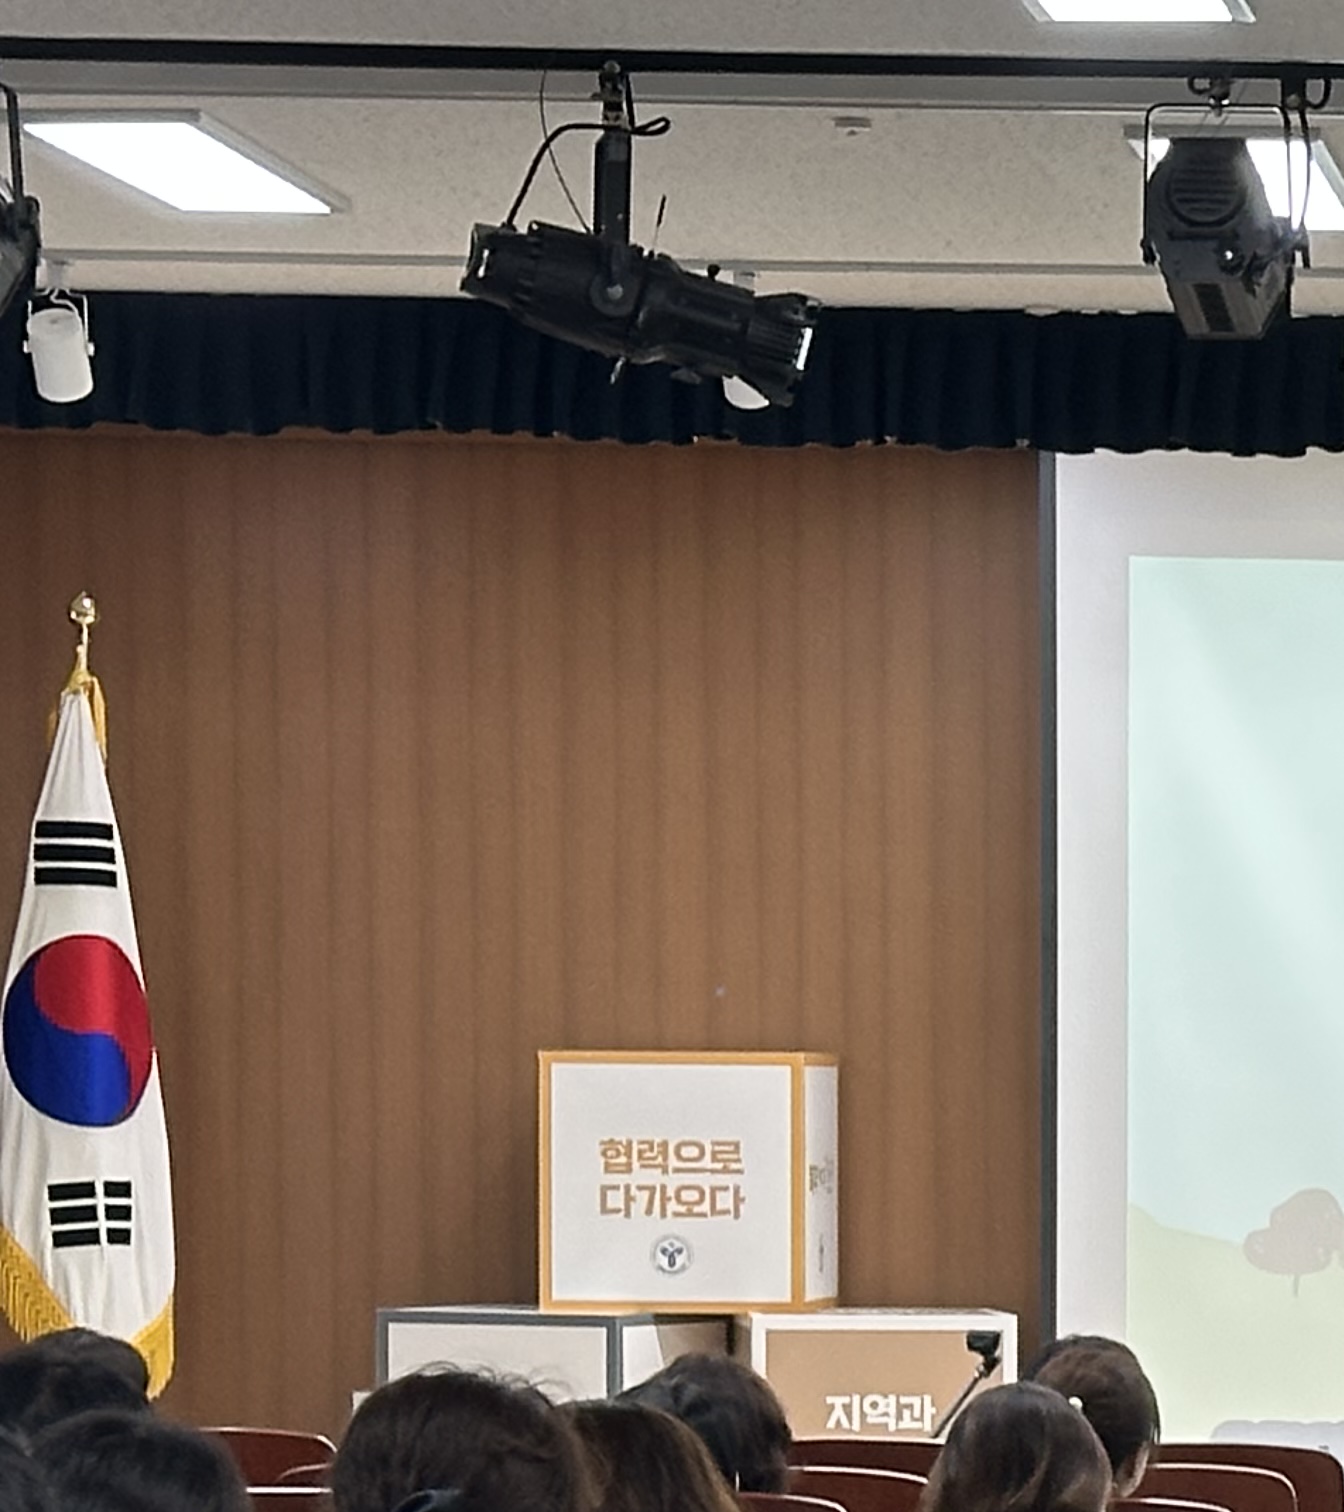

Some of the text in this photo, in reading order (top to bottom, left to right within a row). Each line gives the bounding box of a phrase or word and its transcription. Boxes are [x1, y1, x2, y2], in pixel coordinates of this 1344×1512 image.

[599, 1138, 745, 1176] 협력으로
[600, 1183, 746, 1220] 다가오다
[825, 1393, 937, 1433] 지역과
